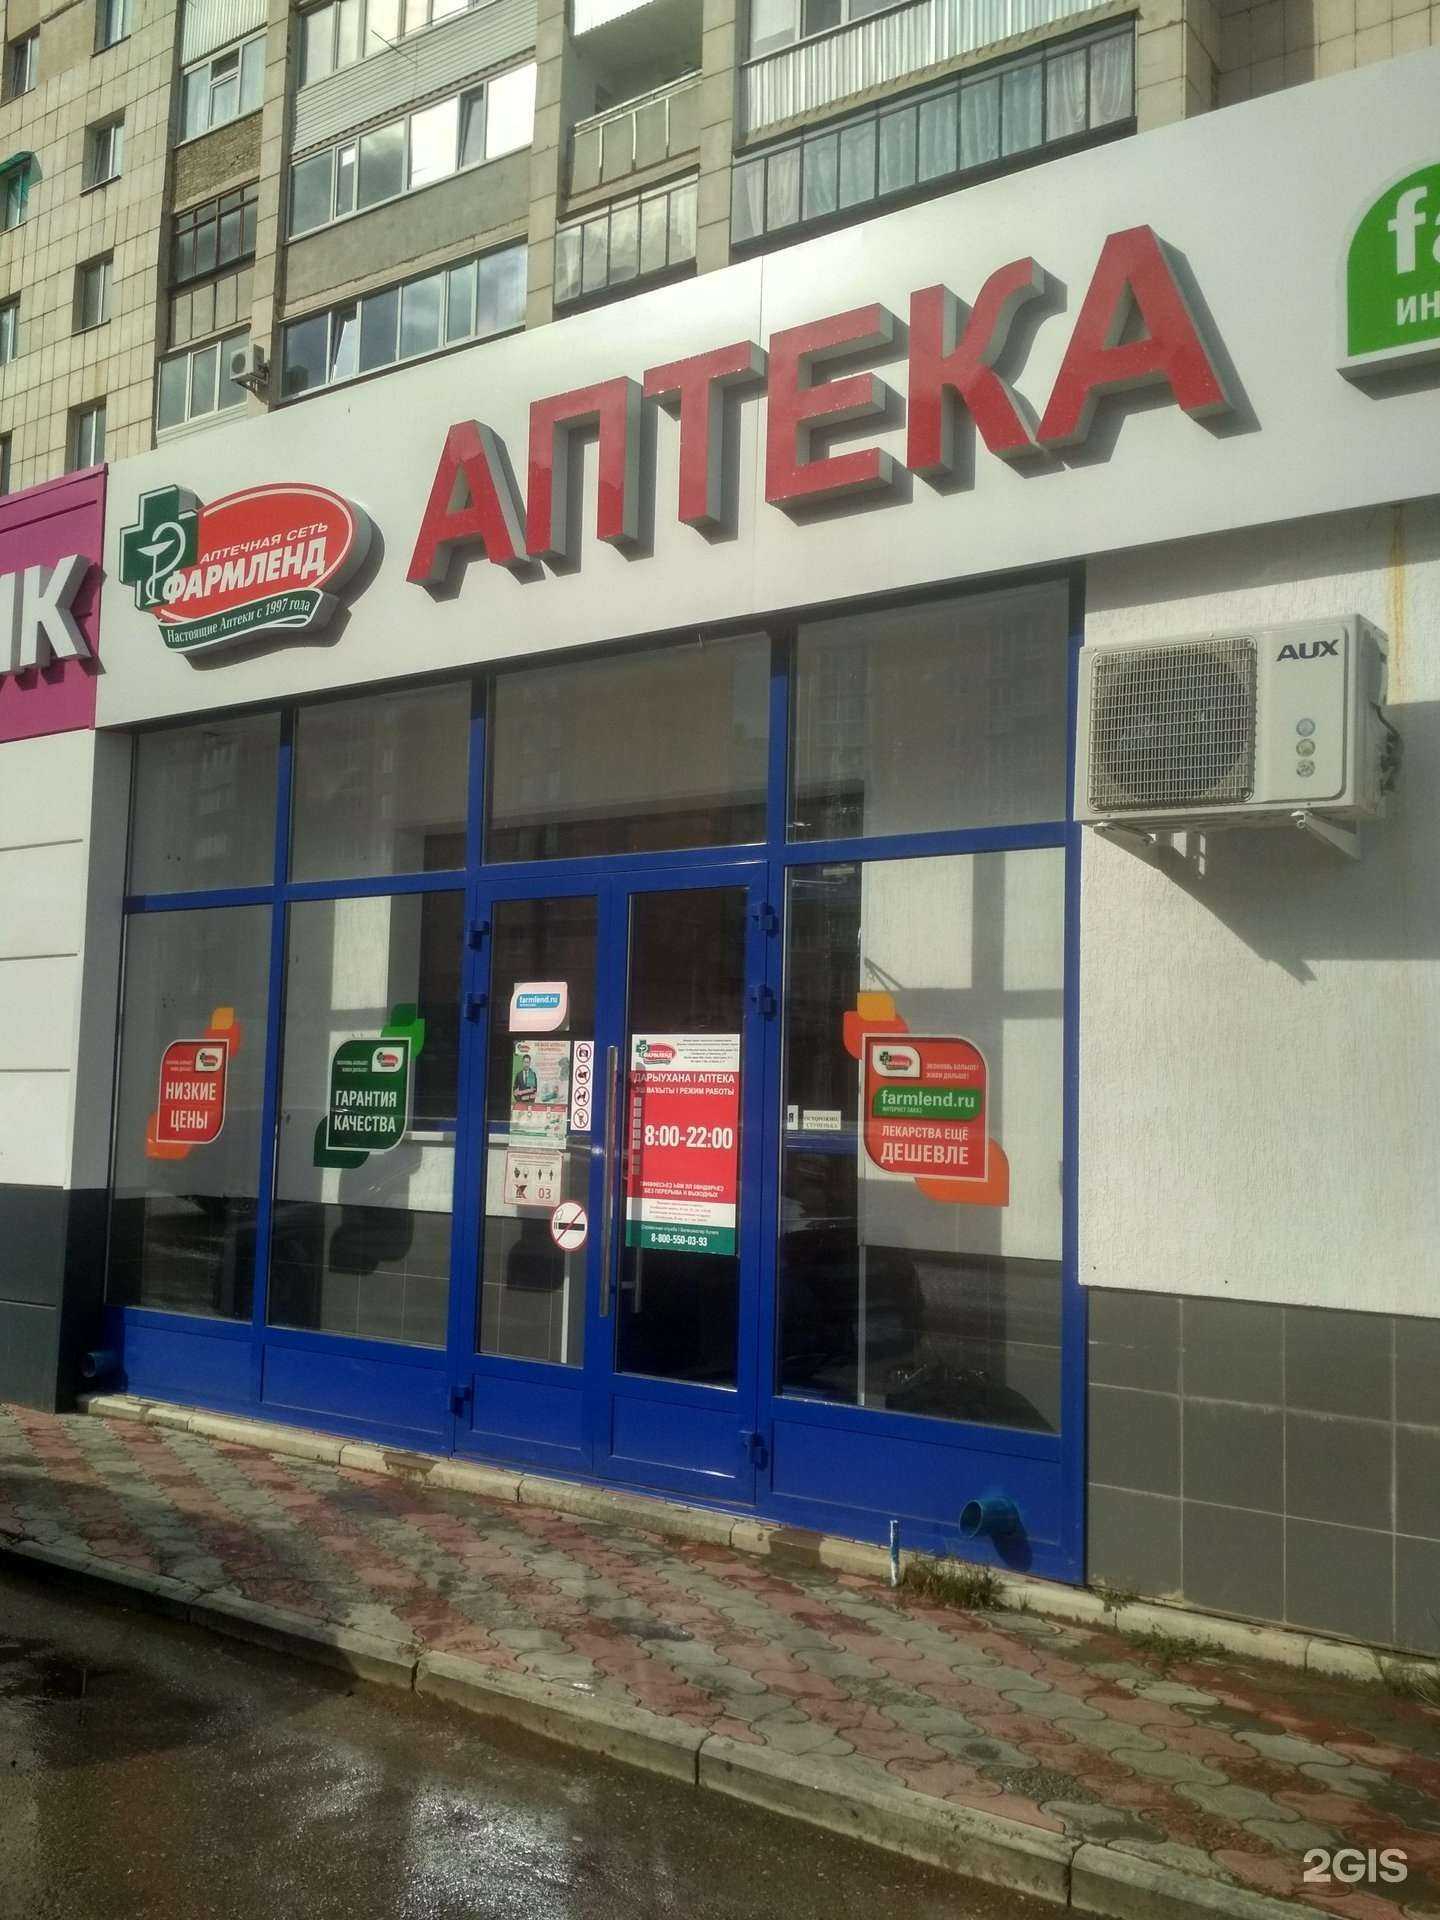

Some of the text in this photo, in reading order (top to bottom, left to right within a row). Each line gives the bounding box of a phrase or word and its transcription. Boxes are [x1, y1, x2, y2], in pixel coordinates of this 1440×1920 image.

[1388, 186, 1440, 275] f
[406, 224, 1235, 588] АПТЕКА
[200, 522, 328, 565] АПТЕЧНАЯ СЕТЬ
[162, 536, 327, 605] ФАРМЛЕНД
[167, 598, 311, 643] Настоящие Аптеки с 1997 года
[1276, 639, 1339, 661] AUX
[698, 1073, 735, 1083] АПТЕКА
[166, 1082, 217, 1101] НИЗКИЕ
[335, 1090, 397, 1107] ГАРАНТИЯ
[680, 1087, 705, 1095] РЕЖИМ
[705, 1087, 735, 1096] РАБОТЫ
[881, 1090, 974, 1108] farmlend.ru
[170, 1110, 208, 1131] ЦЕНЫ
[334, 1114, 396, 1132] КАЧЕСТВА
[644, 1125, 734, 1149] 8:00-22:00
[882, 1125, 942, 1139] ЛЕКАРСТВА
[881, 1142, 969, 1165] ДЕШЕВЛЕ
[650, 1232, 708, 1247] 8-800-550-03-93
